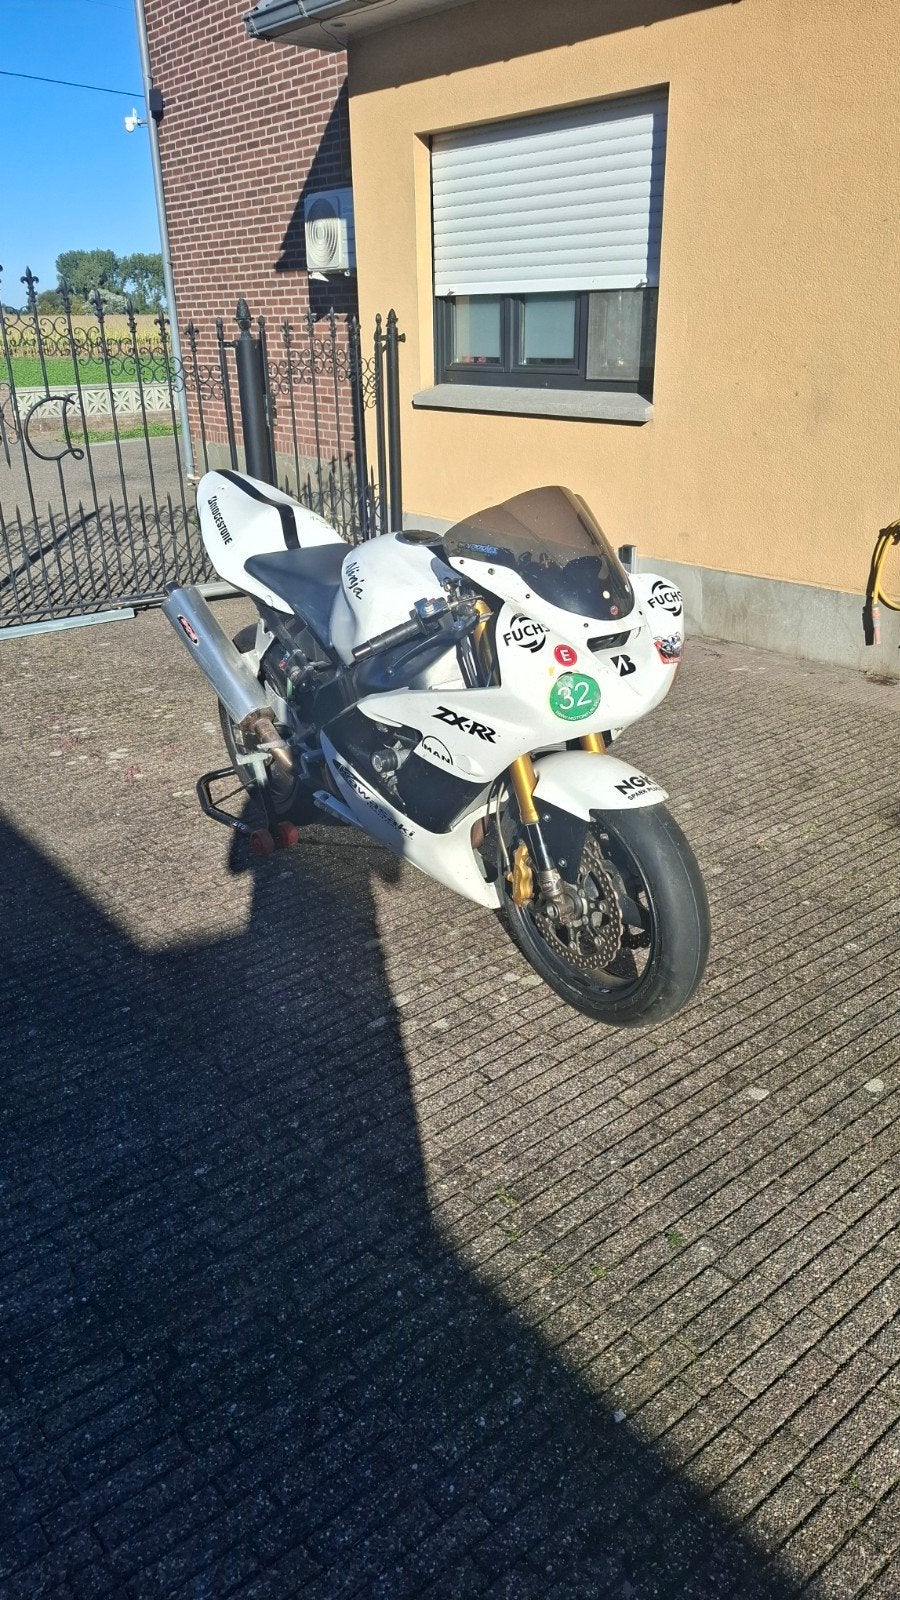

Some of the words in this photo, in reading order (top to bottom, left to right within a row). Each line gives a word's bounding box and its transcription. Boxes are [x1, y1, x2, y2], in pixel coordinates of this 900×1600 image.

[207, 495, 233, 546] BRIDGESTONE
[345, 561, 365, 600] Ninja
[502, 623, 551, 647] FUCHS
[560, 649, 572, 662] E
[557, 681, 593, 710] 32
[423, 743, 451, 765] MAN
